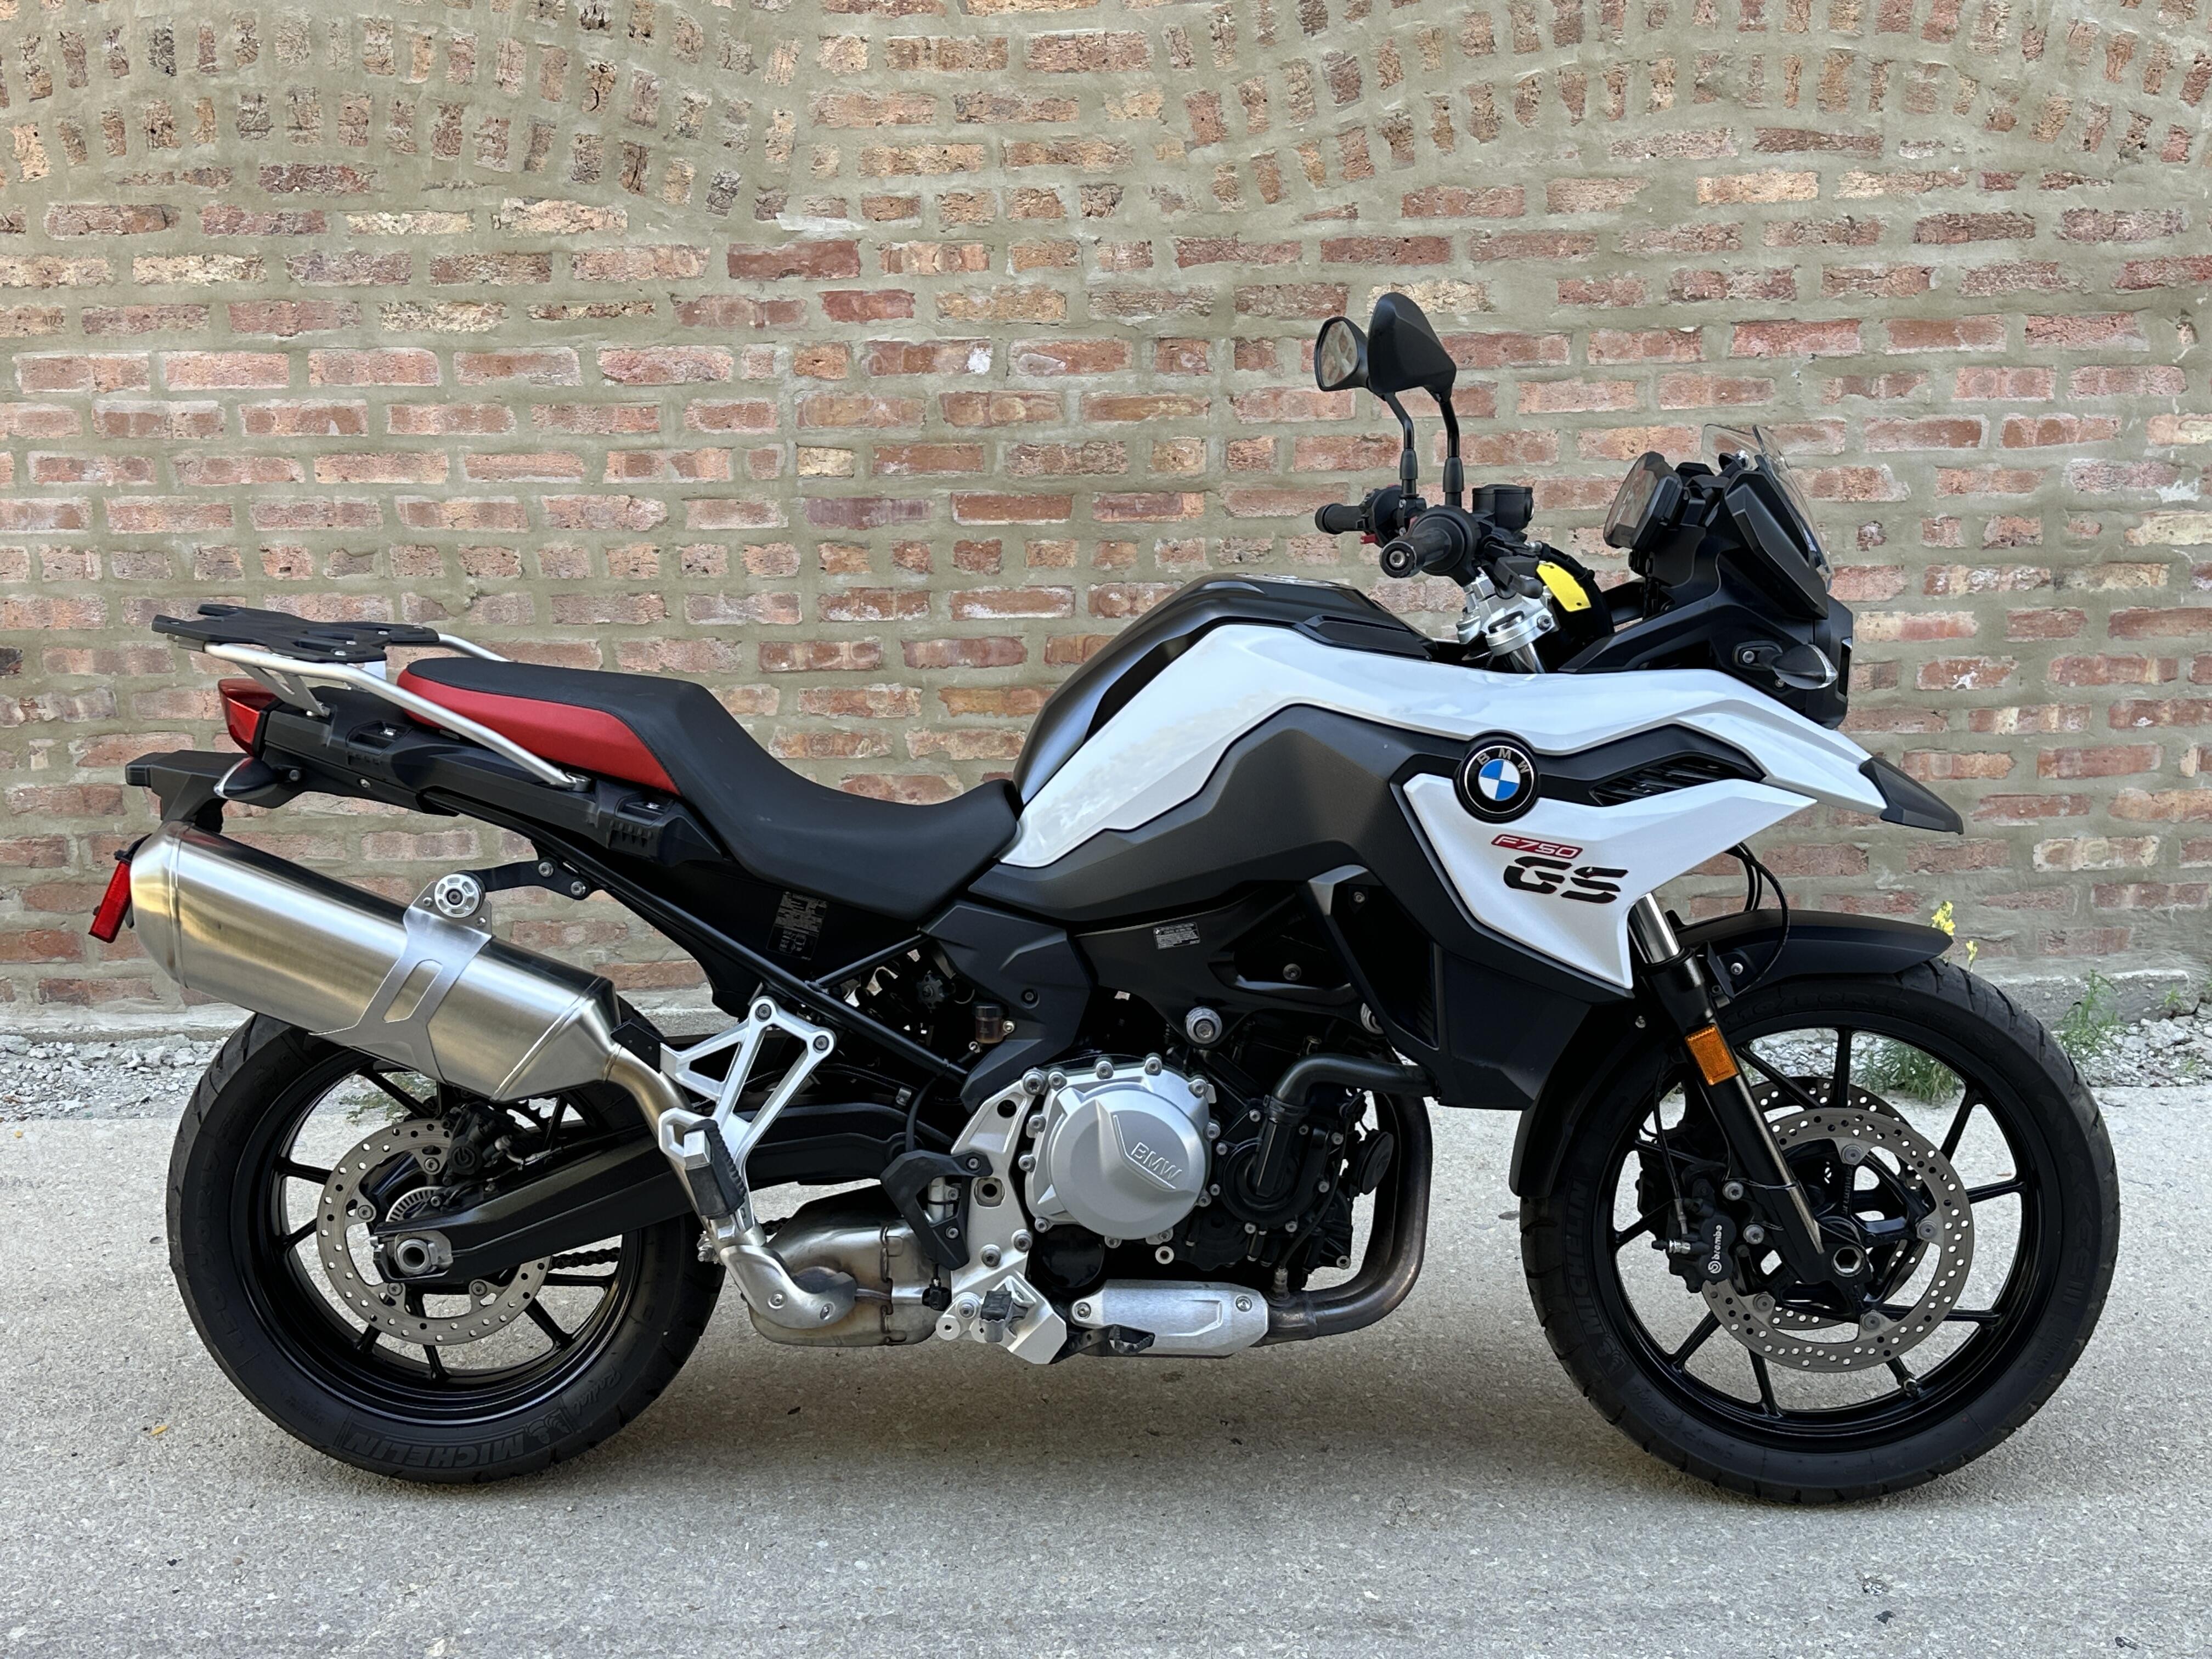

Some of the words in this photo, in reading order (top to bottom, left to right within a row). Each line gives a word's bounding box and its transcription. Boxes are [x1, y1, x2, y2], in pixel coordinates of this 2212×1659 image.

[1478, 747, 1531, 774] BMW
[1494, 836, 1578, 857] F750
[1503, 856, 1629, 904] GS
[1131, 1142, 1182, 1179] BMW
[1566, 1180, 1604, 1336] MICHELIN
[1712, 1224, 1722, 1260] brembo
[572, 1365, 624, 1417] Radial
[345, 1431, 526, 1469] MICHELIN
